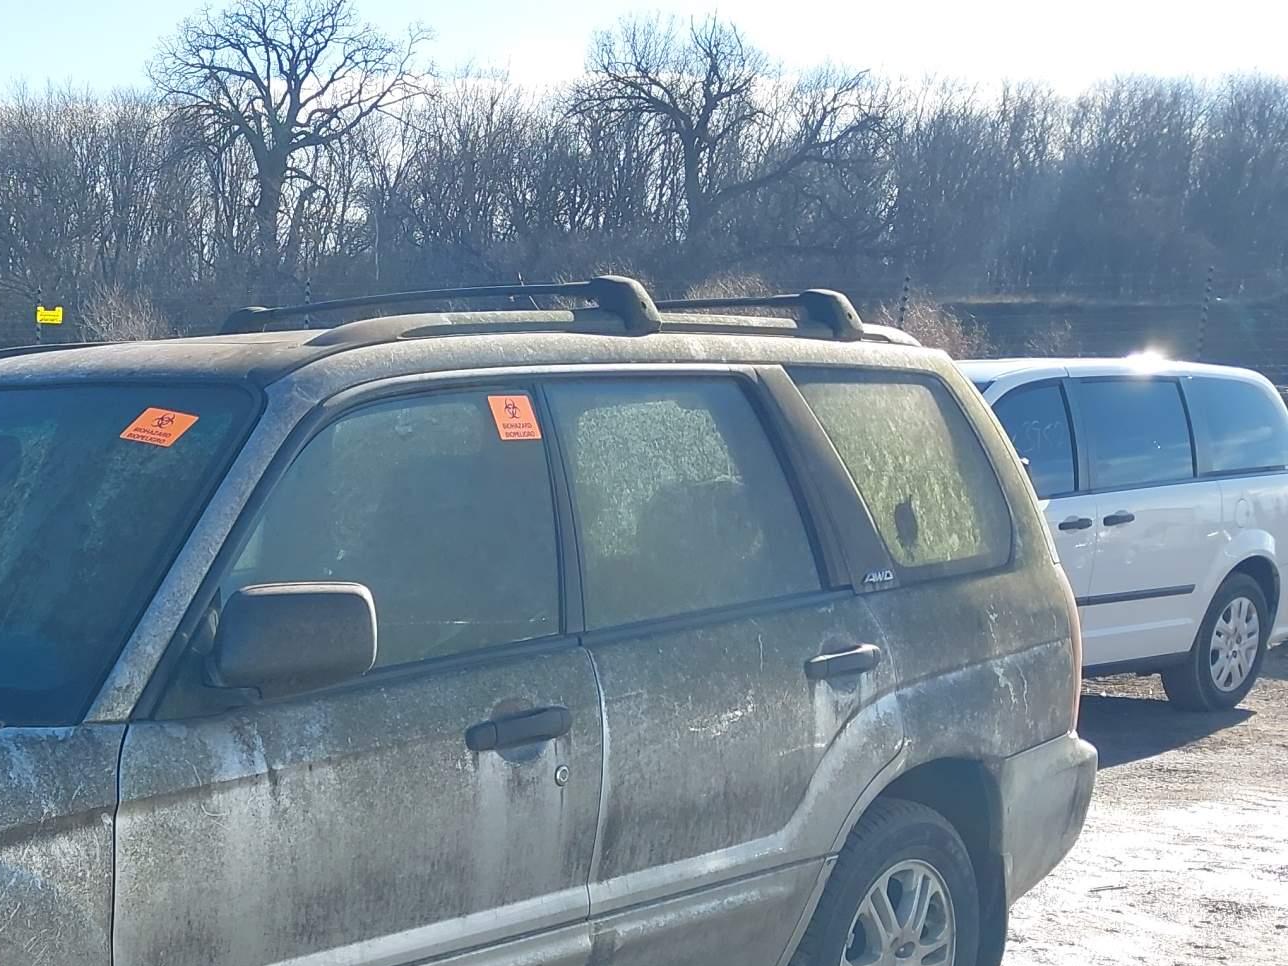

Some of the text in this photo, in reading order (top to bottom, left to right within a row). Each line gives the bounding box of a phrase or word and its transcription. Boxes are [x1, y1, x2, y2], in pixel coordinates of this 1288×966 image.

[133, 426, 173, 439] BIOHAZARD
[502, 422, 533, 430] BIOHAZARD
[863, 569, 894, 583] AWD
